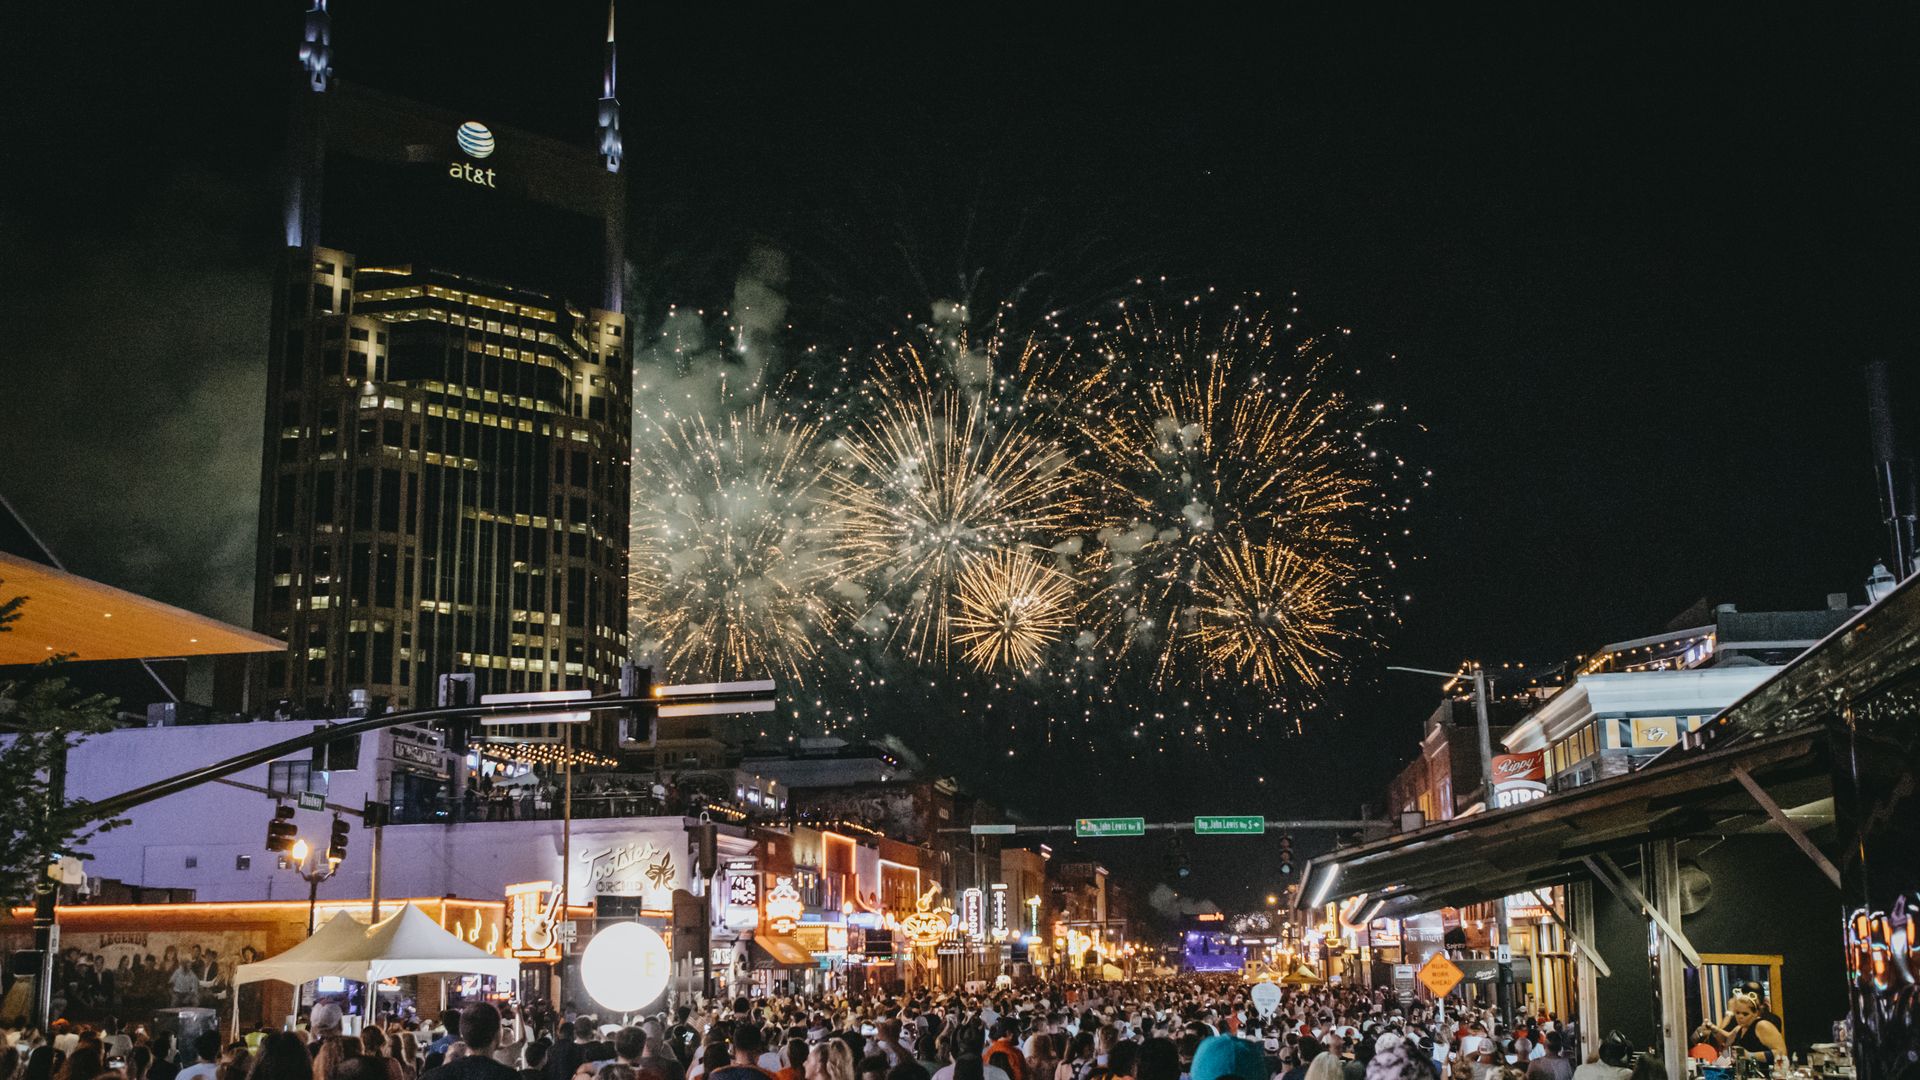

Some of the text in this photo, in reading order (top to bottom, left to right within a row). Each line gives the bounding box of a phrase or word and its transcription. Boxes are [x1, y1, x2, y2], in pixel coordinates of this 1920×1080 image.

[449, 162, 496, 188] at&t
[1494, 751, 1542, 775] Rippy's
[300, 792, 323, 810] Broadway
[1100, 822, 1111, 831] John
[1112, 821, 1127, 831] Lewis
[1136, 821, 1141, 831] N
[1210, 819, 1222, 829] John
[1223, 819, 1239, 829] Lewis
[1248, 819, 1252, 830] S
[596, 881, 643, 892] ORCHID
[99, 933, 148, 949] LEGENDS
